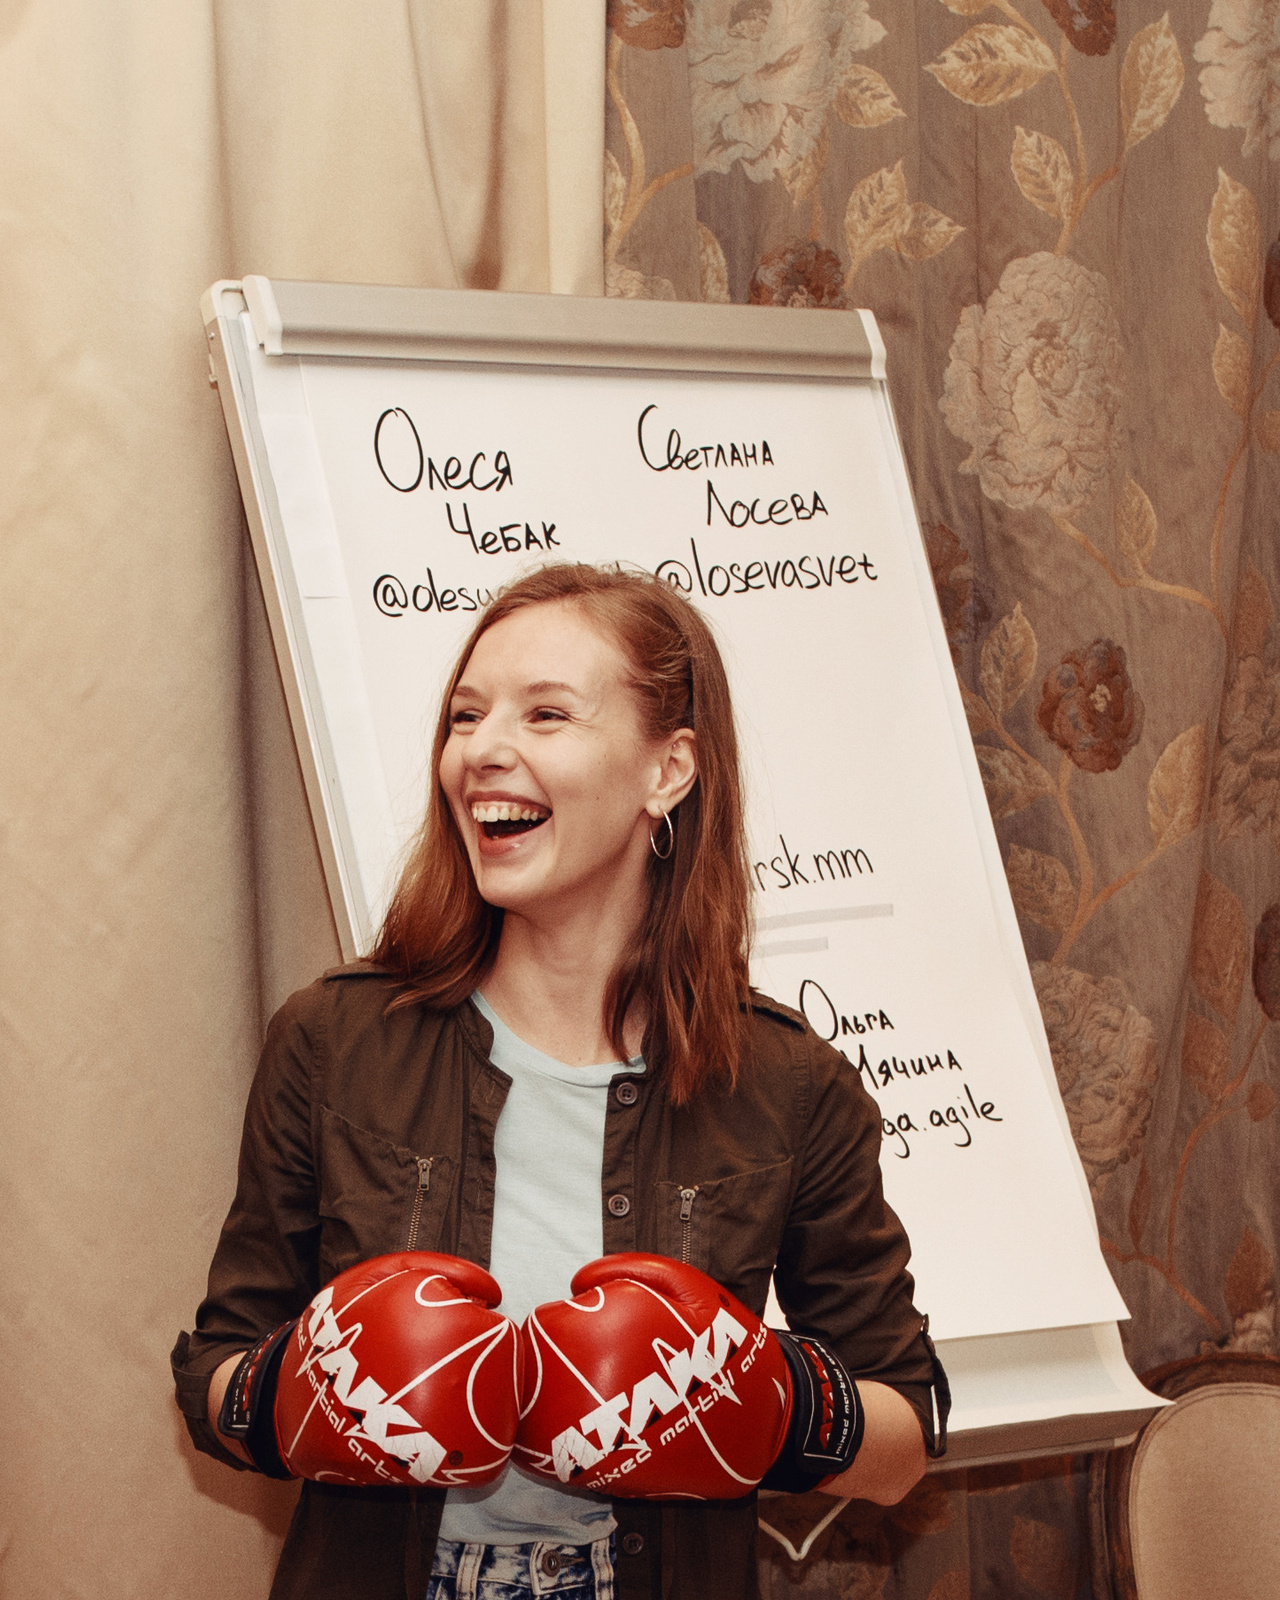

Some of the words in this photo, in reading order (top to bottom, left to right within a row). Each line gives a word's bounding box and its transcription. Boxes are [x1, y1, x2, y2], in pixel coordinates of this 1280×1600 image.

[373, 406, 514, 493] Олеся
[637, 403, 776, 472] Светлана
[706, 479, 829, 528] Лосева
[653, 536, 880, 597] @losevasvet
[752, 833, 875, 892] rsk.mm
[799, 979, 895, 1042] Ольга
[881, 1082, 1004, 1160] ga.agile
[739, 1322, 769, 1374] arts
[308, 1285, 448, 1484] ATAKA
[551, 1306, 749, 1484] ATAKA
